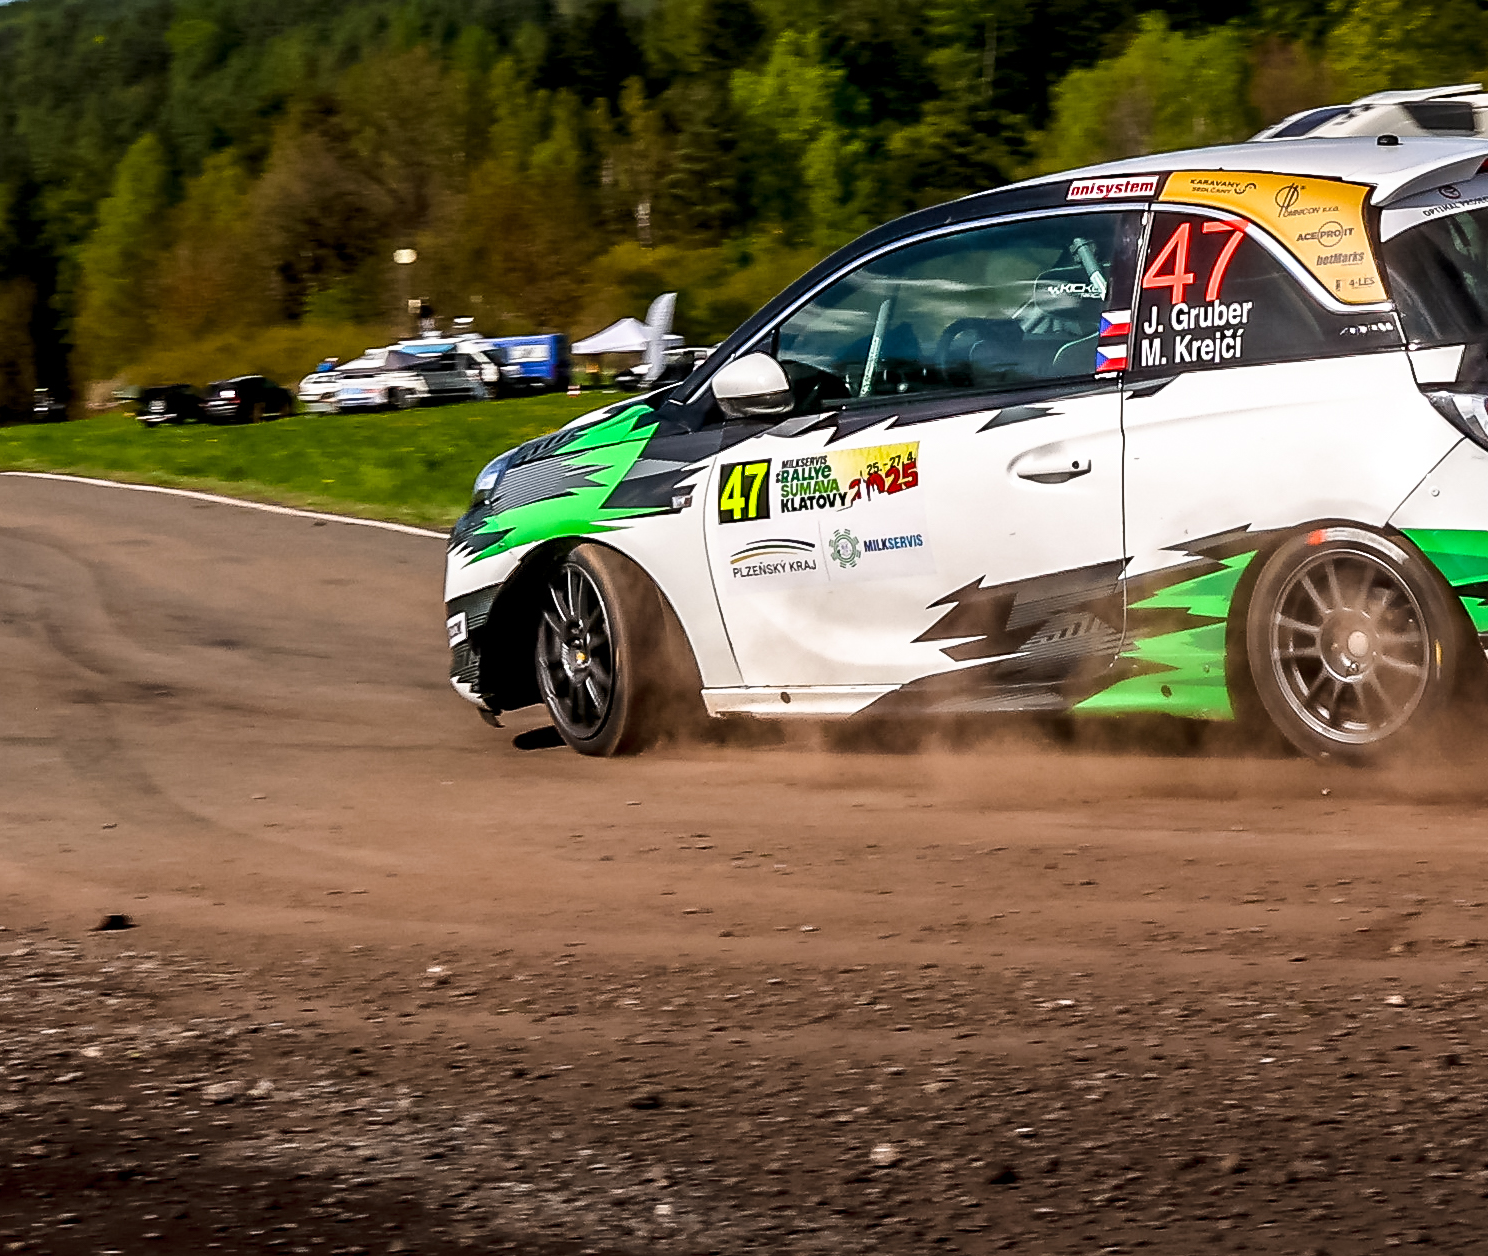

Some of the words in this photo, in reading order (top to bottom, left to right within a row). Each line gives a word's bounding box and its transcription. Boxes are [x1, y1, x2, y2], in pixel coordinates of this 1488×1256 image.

[1142, 218, 1250, 305] 47
[1143, 306, 1164, 334] J.
[1171, 299, 1253, 331] Gruber
[1141, 338, 1167, 367] M.
[1174, 329, 1244, 363] Krejčí
[782, 455, 827, 469] MILKSERVIS
[721, 463, 768, 520] 47
[781, 492, 848, 513] KLATOVY
[864, 534, 923, 552] MILKSERVIS
[789, 559, 817, 572] KRAJ
